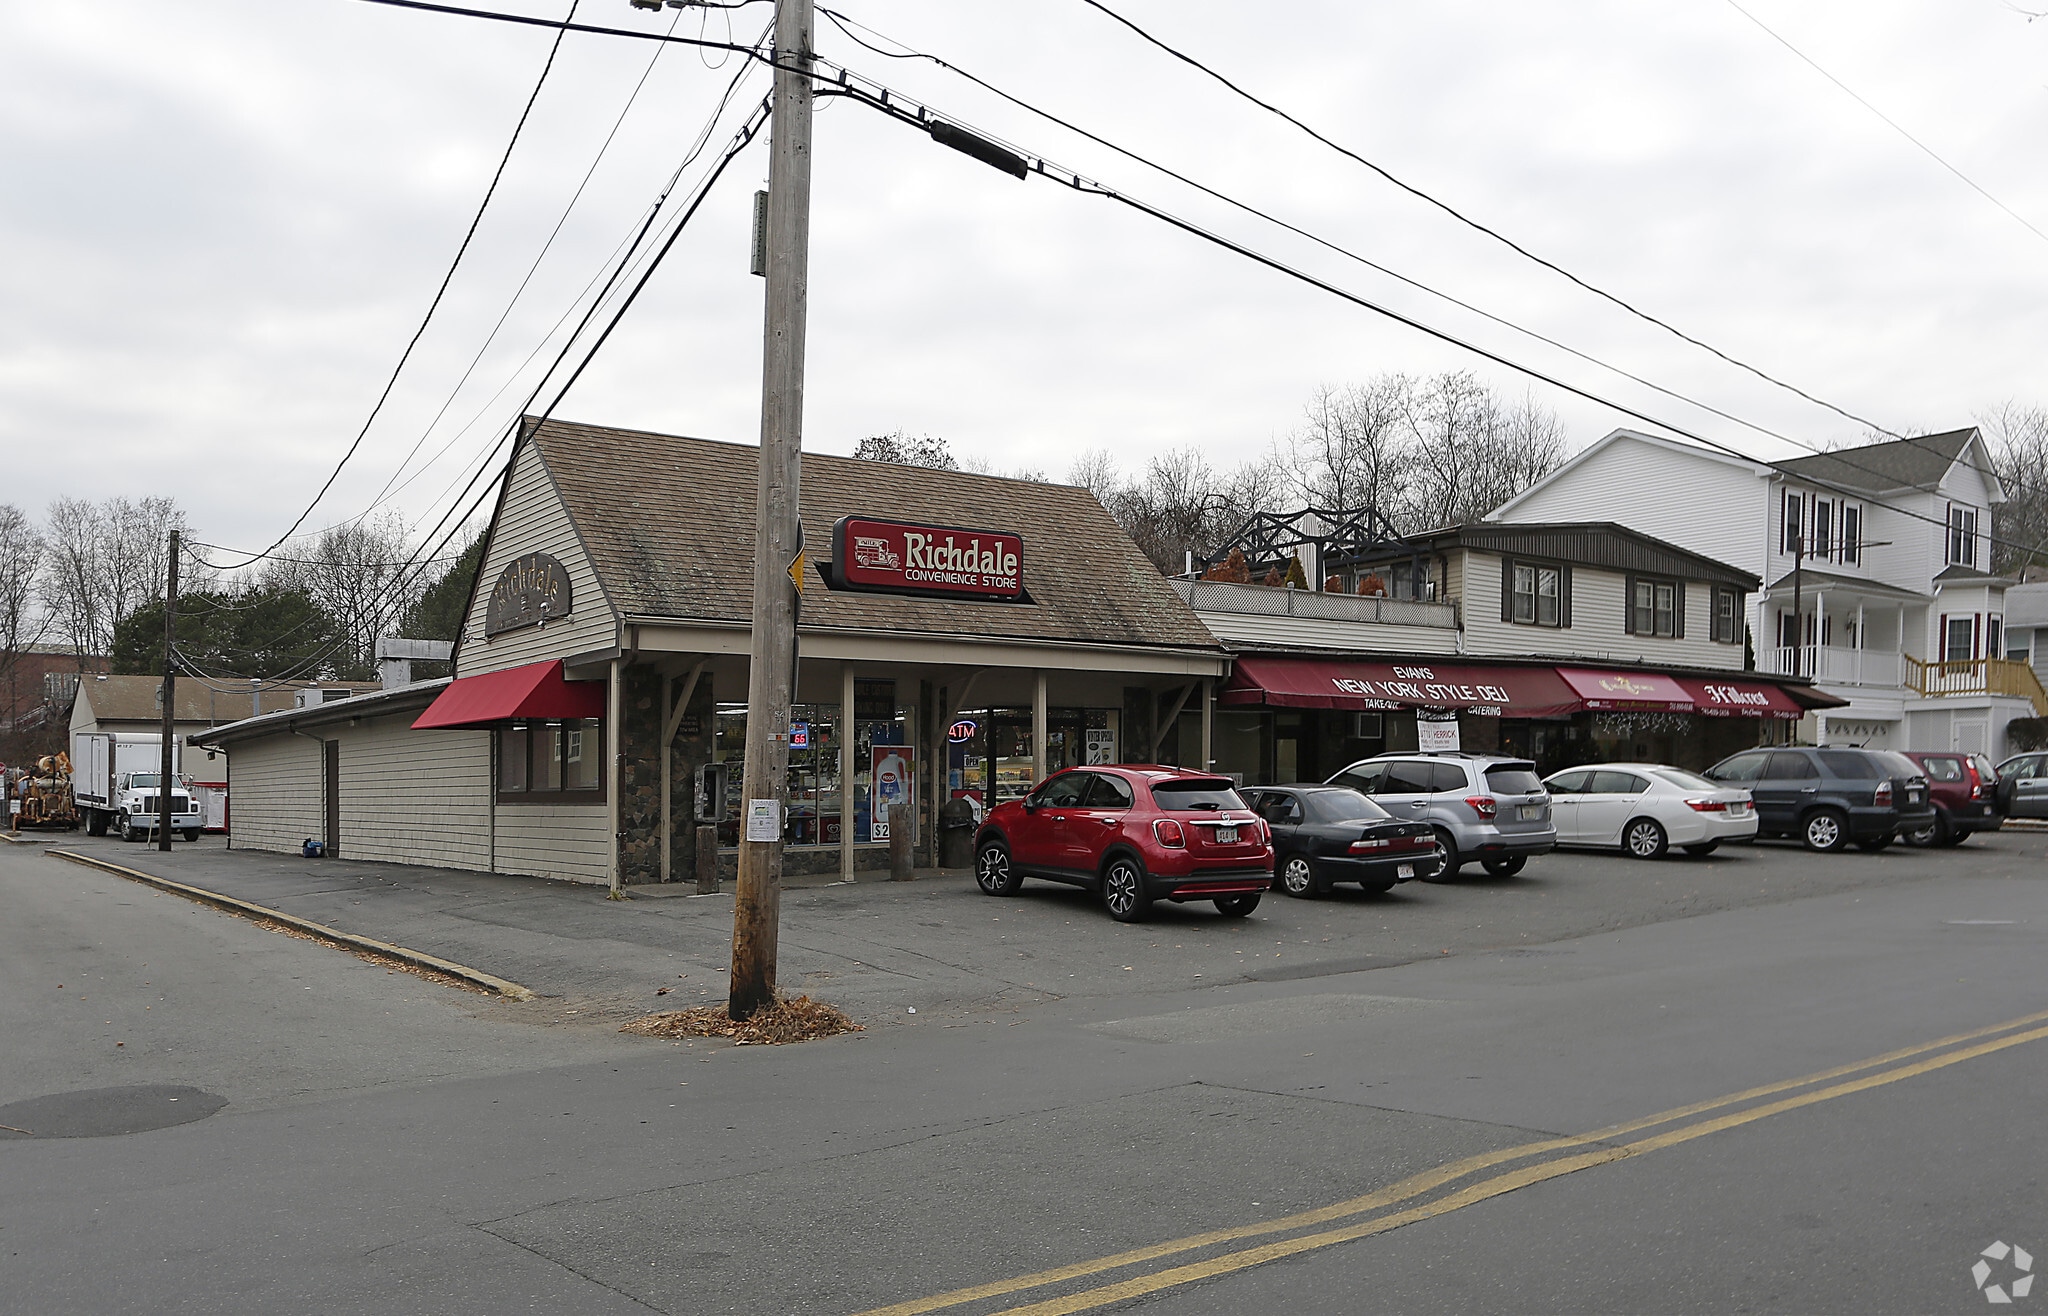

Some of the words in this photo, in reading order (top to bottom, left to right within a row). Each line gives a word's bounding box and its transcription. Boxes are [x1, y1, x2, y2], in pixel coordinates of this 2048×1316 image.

[903, 532, 1017, 576] Richdale
[905, 569, 977, 586] CONVENIENCE
[982, 575, 1017, 589] STORE
[1393, 666, 1435, 680] EVAN'S
[1332, 678, 1376, 694] NEW
[1375, 681, 1427, 699] YORK
[1425, 684, 1478, 701] STYLE
[1475, 686, 1511, 703] DELI
[1704, 684, 1770, 706] Hillcrest
[1467, 705, 1502, 717] CATERING
[948, 725, 975, 738] ATM
[794, 734, 806, 744] 66
[965, 757, 979, 767] OPEN
